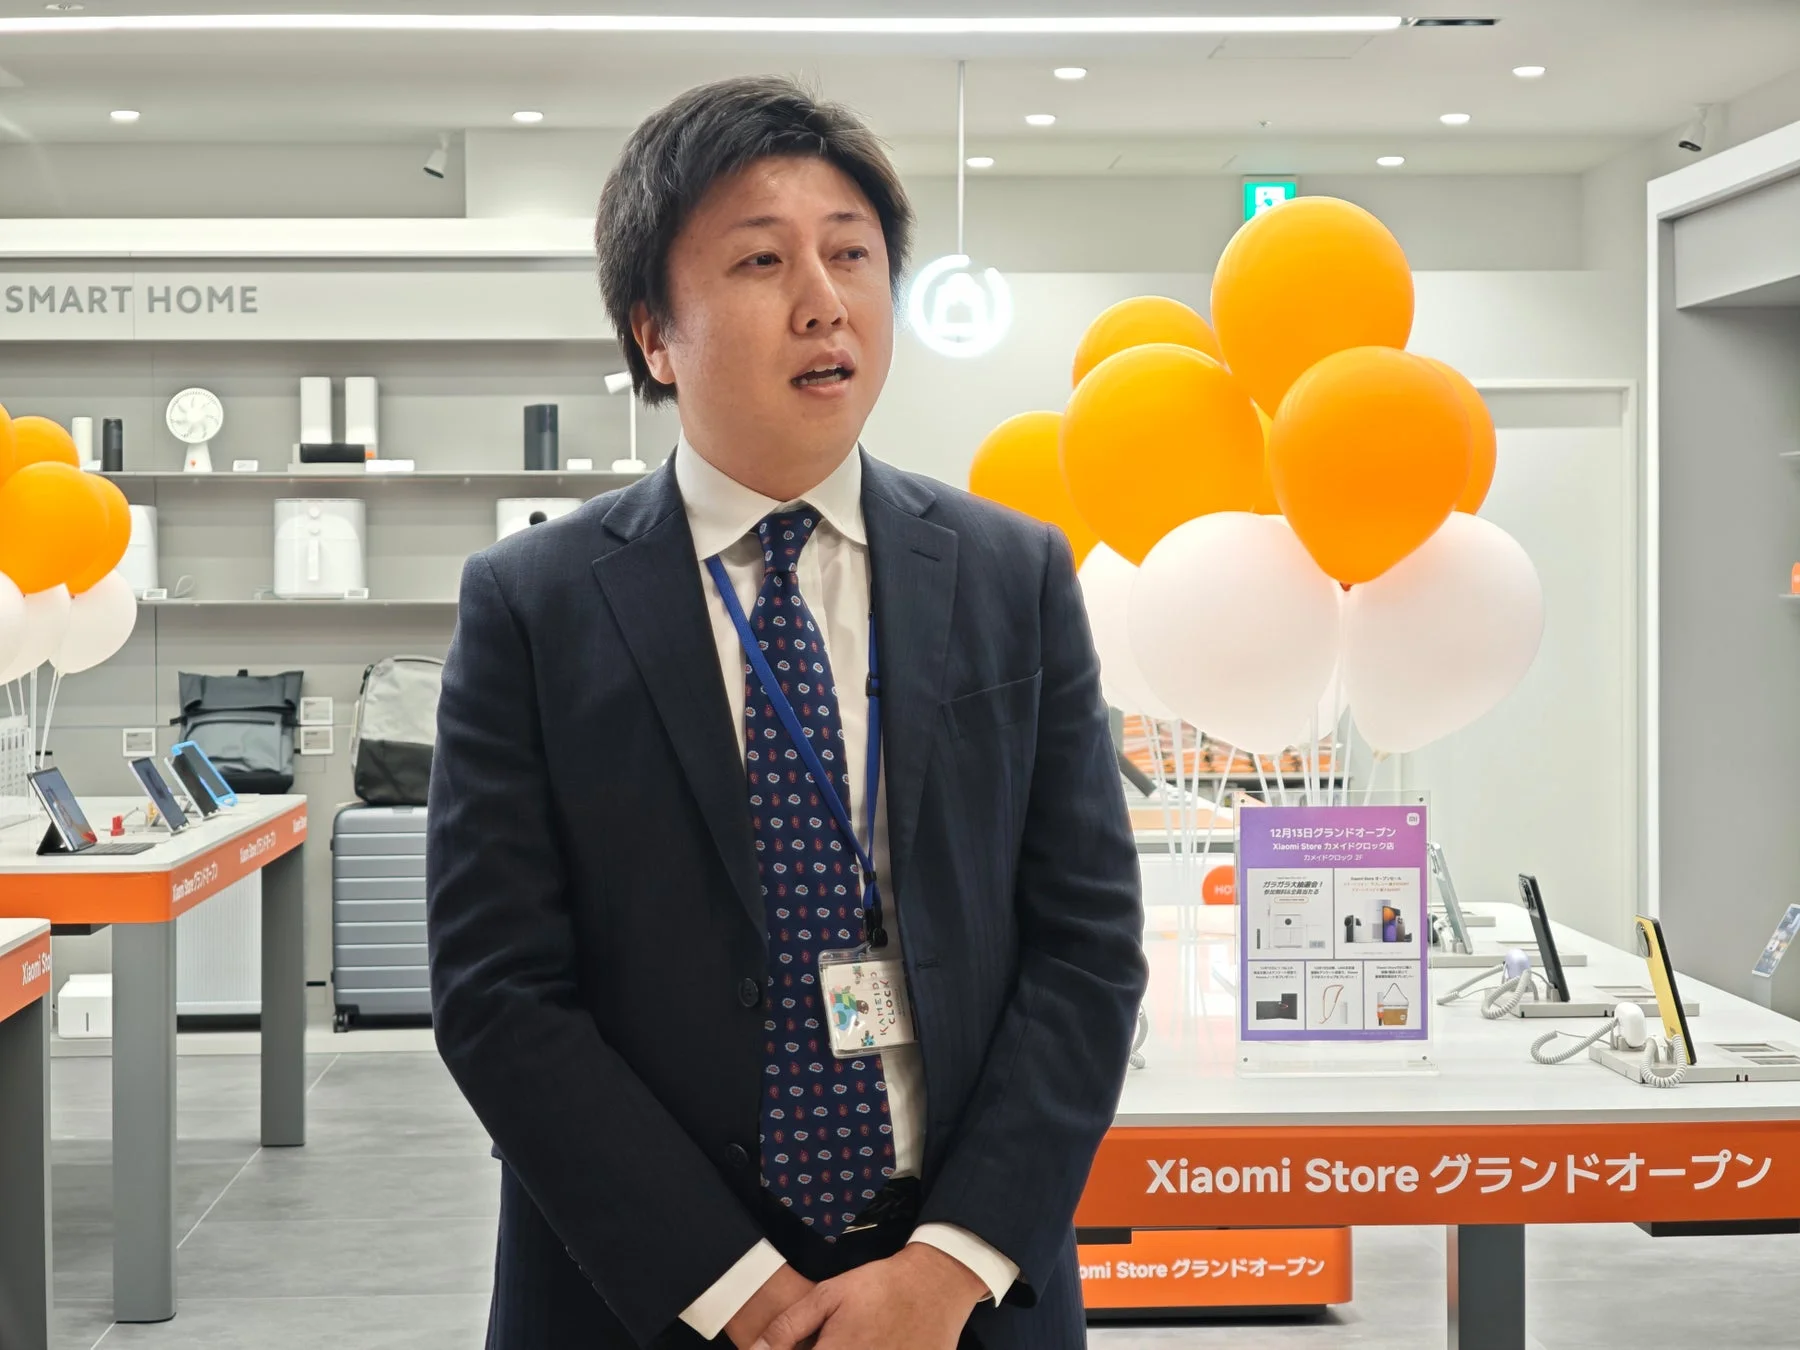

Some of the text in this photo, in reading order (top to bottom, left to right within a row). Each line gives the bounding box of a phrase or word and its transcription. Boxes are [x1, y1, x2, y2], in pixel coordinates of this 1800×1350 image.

[5, 285, 259, 314] SMART HOME
[1270, 827, 1397, 839] 12月13日グランドオープン
[1272, 842, 1395, 851] Xiaomi Store カメイドクロック店
[1145, 1149, 1773, 1195] Xiaomi Store グランドオープン
[1079, 1256, 1326, 1280] omi Store グランドオープン
